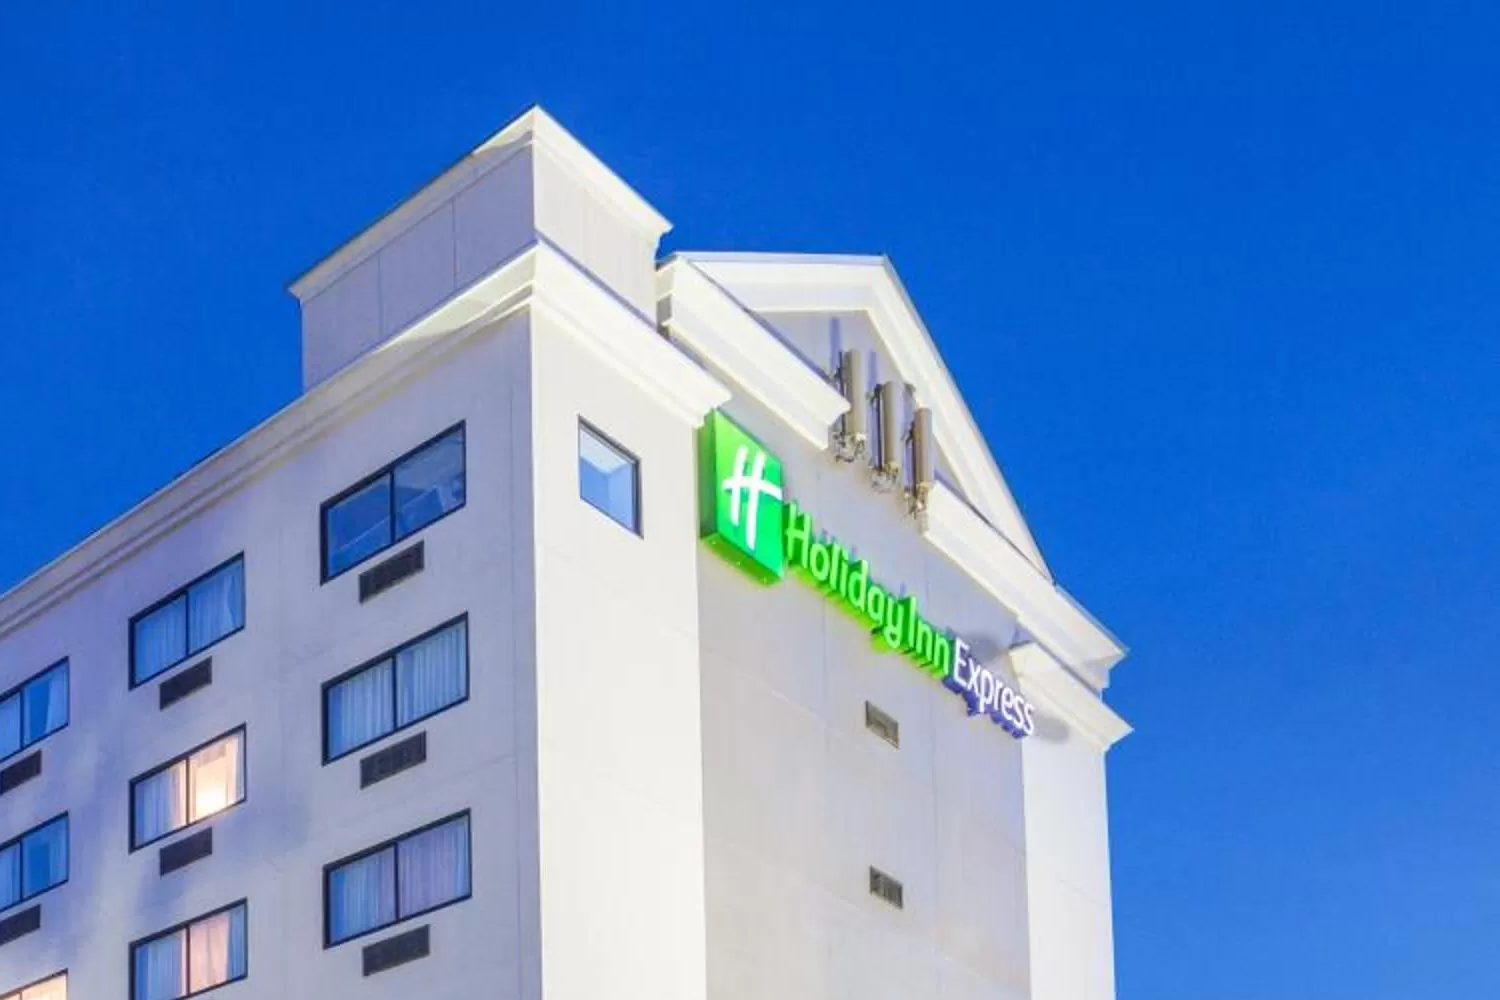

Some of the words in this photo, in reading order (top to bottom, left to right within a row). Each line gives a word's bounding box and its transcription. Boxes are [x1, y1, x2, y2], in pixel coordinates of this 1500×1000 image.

[785, 500, 904, 648] Holiday
[908, 595, 950, 676] Inn
[953, 637, 1035, 735] Express
